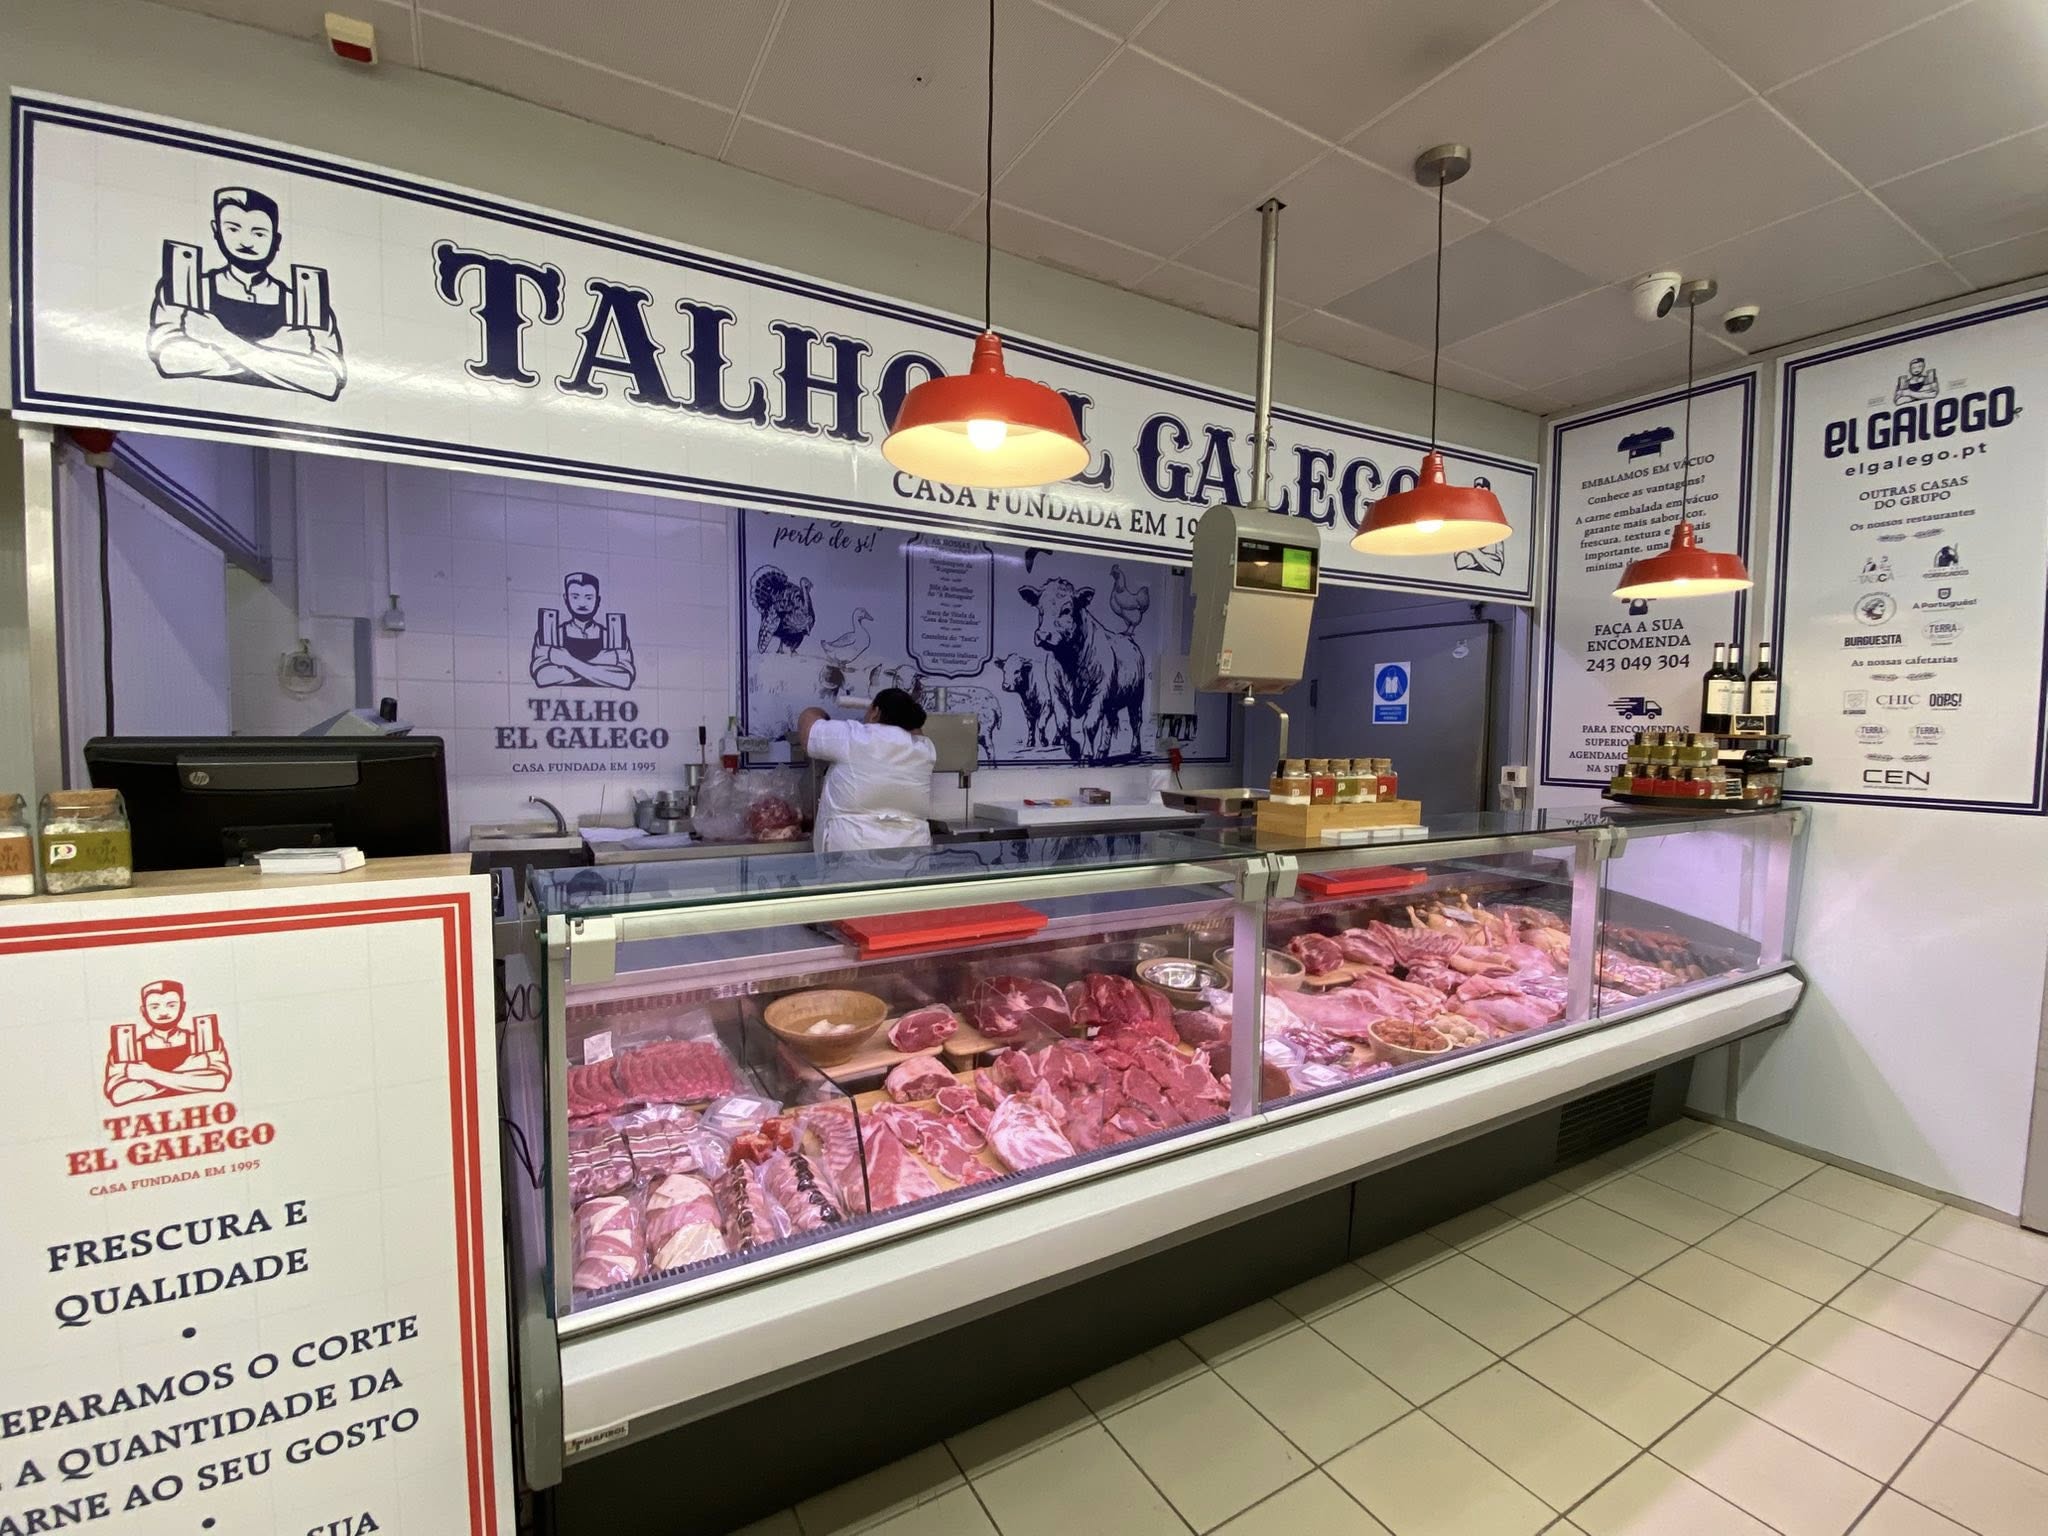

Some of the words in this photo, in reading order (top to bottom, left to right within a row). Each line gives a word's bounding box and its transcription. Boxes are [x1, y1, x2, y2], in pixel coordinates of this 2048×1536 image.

[1844, 441, 1988, 478] elgalego.pt
[1581, 468, 1649, 489] EMBALAMOS
[1652, 464, 1670, 476] EM
[1587, 491, 1630, 505] Conhece
[1632, 489, 1643, 497] as
[1646, 474, 1706, 494] vantagens?
[1858, 483, 1916, 502] OUTRAS
[1918, 475, 1968, 495] CASAS
[893, 470, 977, 508] CASA
[986, 490, 1122, 529] FUNDADA
[1130, 510, 1168, 536] EM
[1175, 516, 1199, 542] 19
[1874, 499, 1896, 510] DO
[1900, 490, 1952, 506] GRUPO
[1576, 516, 1582, 525] A
[1585, 513, 1611, 523] carne
[1613, 502, 1663, 518] embalada
[1666, 499, 1683, 508] em
[1849, 523, 1864, 531] Os
[1867, 518, 1903, 529] nossos
[1906, 509, 1976, 524] restaurantes
[773, 522, 825, 549] perto
[829, 528, 850, 549] de
[1584, 523, 1621, 538] garante
[1623, 518, 1648, 529] mais
[1625, 529, 1661, 542] textura
[1692, 521, 1711, 531] ais
[1646, 541, 1669, 551] uma
[1594, 622, 1632, 639] FAÇA
[1635, 621, 1648, 634] A
[1652, 618, 1684, 631] SUA
[1929, 623, 1958, 634] TERRA
[1587, 634, 1691, 652] ENCOMENDA
[1844, 633, 1902, 647] BURGUESITA
[1586, 658, 1616, 672] 243
[1620, 655, 1652, 671] 049
[1658, 653, 1691, 669] 304
[1851, 659, 1864, 667] As
[1867, 658, 1902, 667] nossas
[1905, 655, 1958, 665] cafetarias
[528, 699, 639, 722] TALHO
[1876, 694, 1921, 706] CHIC
[494, 726, 538, 750] EL
[546, 726, 669, 750] GALEGO
[1582, 725, 1608, 734] PARA
[1610, 724, 1689, 735] ENCOMENDAS
[1585, 737, 1632, 747] SUPERIO
[512, 763, 545, 773] CASA
[548, 762, 608, 773] FUNDADA
[610, 762, 628, 772] EM
[631, 761, 656, 772] 1995
[1569, 751, 1629, 761] AGENDAMO
[1586, 764, 1601, 773] NA
[1604, 764, 1619, 773] SU
[1863, 769, 1930, 785] CEN
[104, 1102, 238, 1141] TALHO
[66, 1146, 118, 1178] EL
[126, 1122, 277, 1168] GALEGO
[89, 1182, 127, 1197] CASA
[131, 1170, 201, 1191] FUNDADA
[204, 1164, 227, 1178] EM
[230, 1159, 261, 1174] 1995
[47, 1207, 273, 1274] FRESCURA
[284, 1199, 308, 1227] E
[54, 1248, 309, 1330] QUALIDADE
[0, 1362, 235, 1441] EPARAMOS
[247, 1353, 279, 1380] O
[291, 1315, 420, 1370] CORTE
[15, 1459, 46, 1488] A
[58, 1383, 338, 1482] QUANTIDADE
[349, 1366, 403, 1404] DA
[0, 1491, 111, 1536] ARNE
[123, 1475, 184, 1512] AO
[197, 1449, 272, 1491] SEU
[285, 1407, 420, 1465] GOSTO
